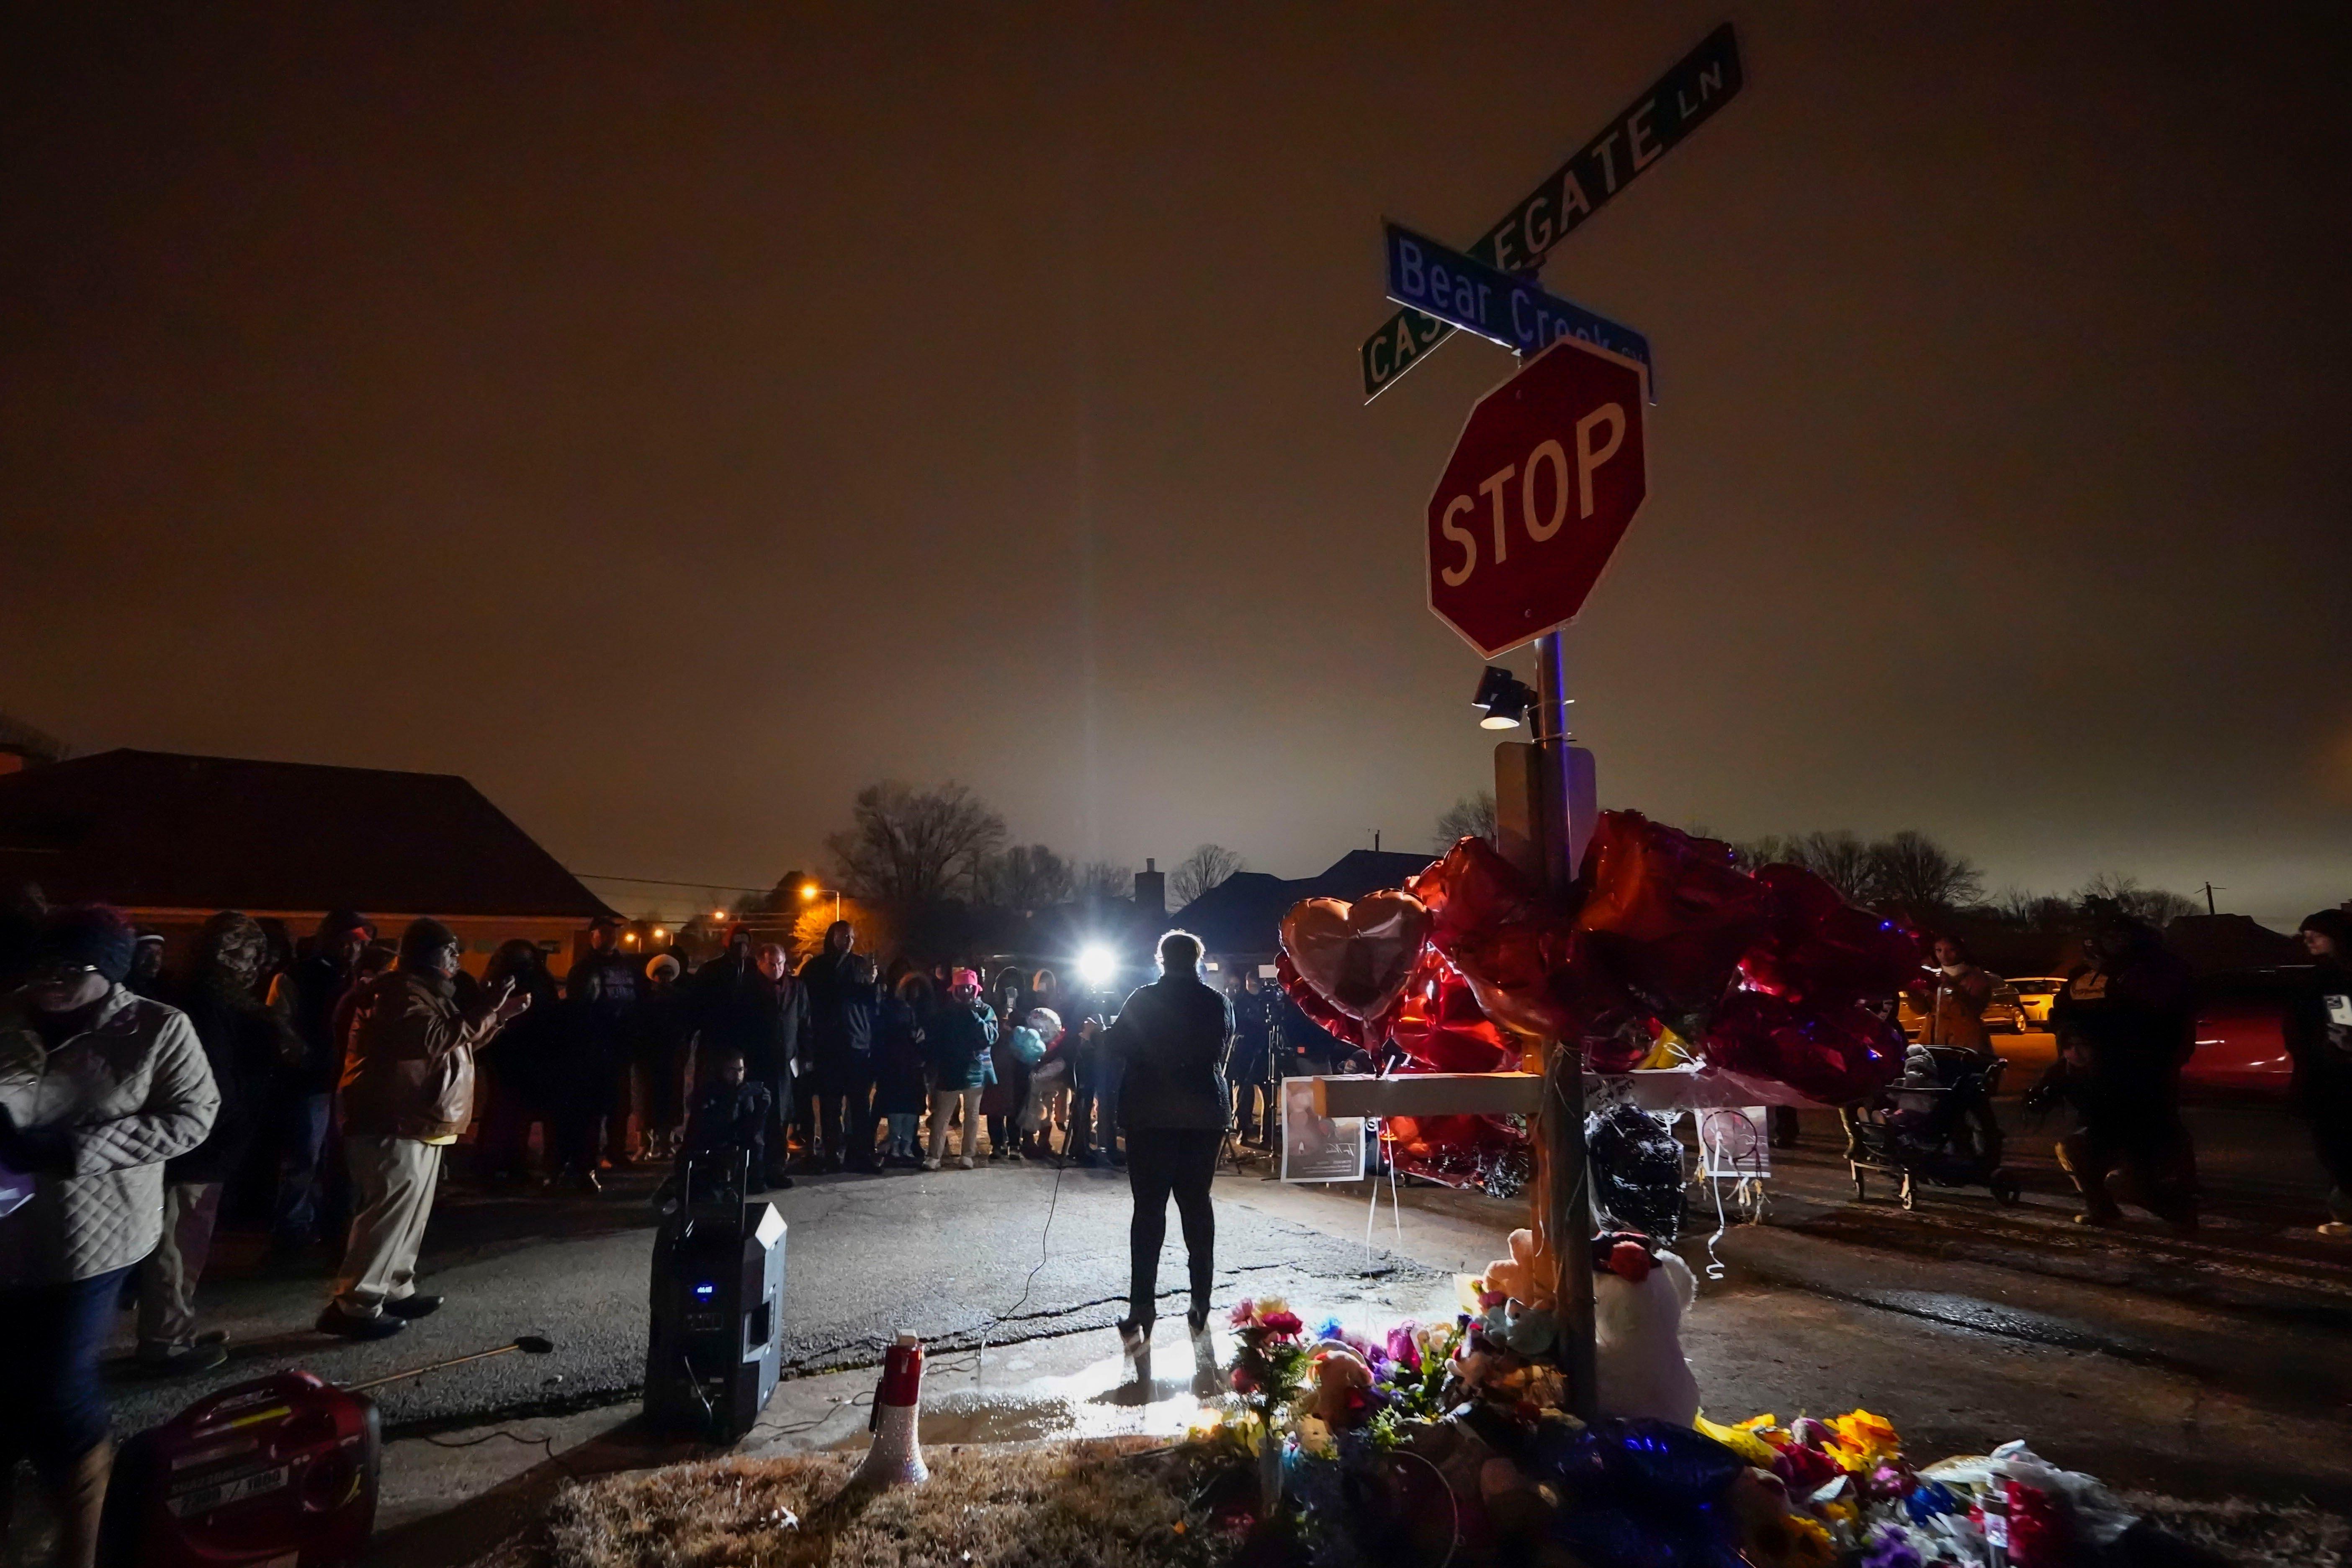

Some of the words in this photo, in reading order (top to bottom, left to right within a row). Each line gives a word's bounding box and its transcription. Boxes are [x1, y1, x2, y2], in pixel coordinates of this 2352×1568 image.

[1677, 60, 1722, 119] LN
[1399, 236, 1492, 325] Bear
[1441, 402, 1626, 587] STOP
